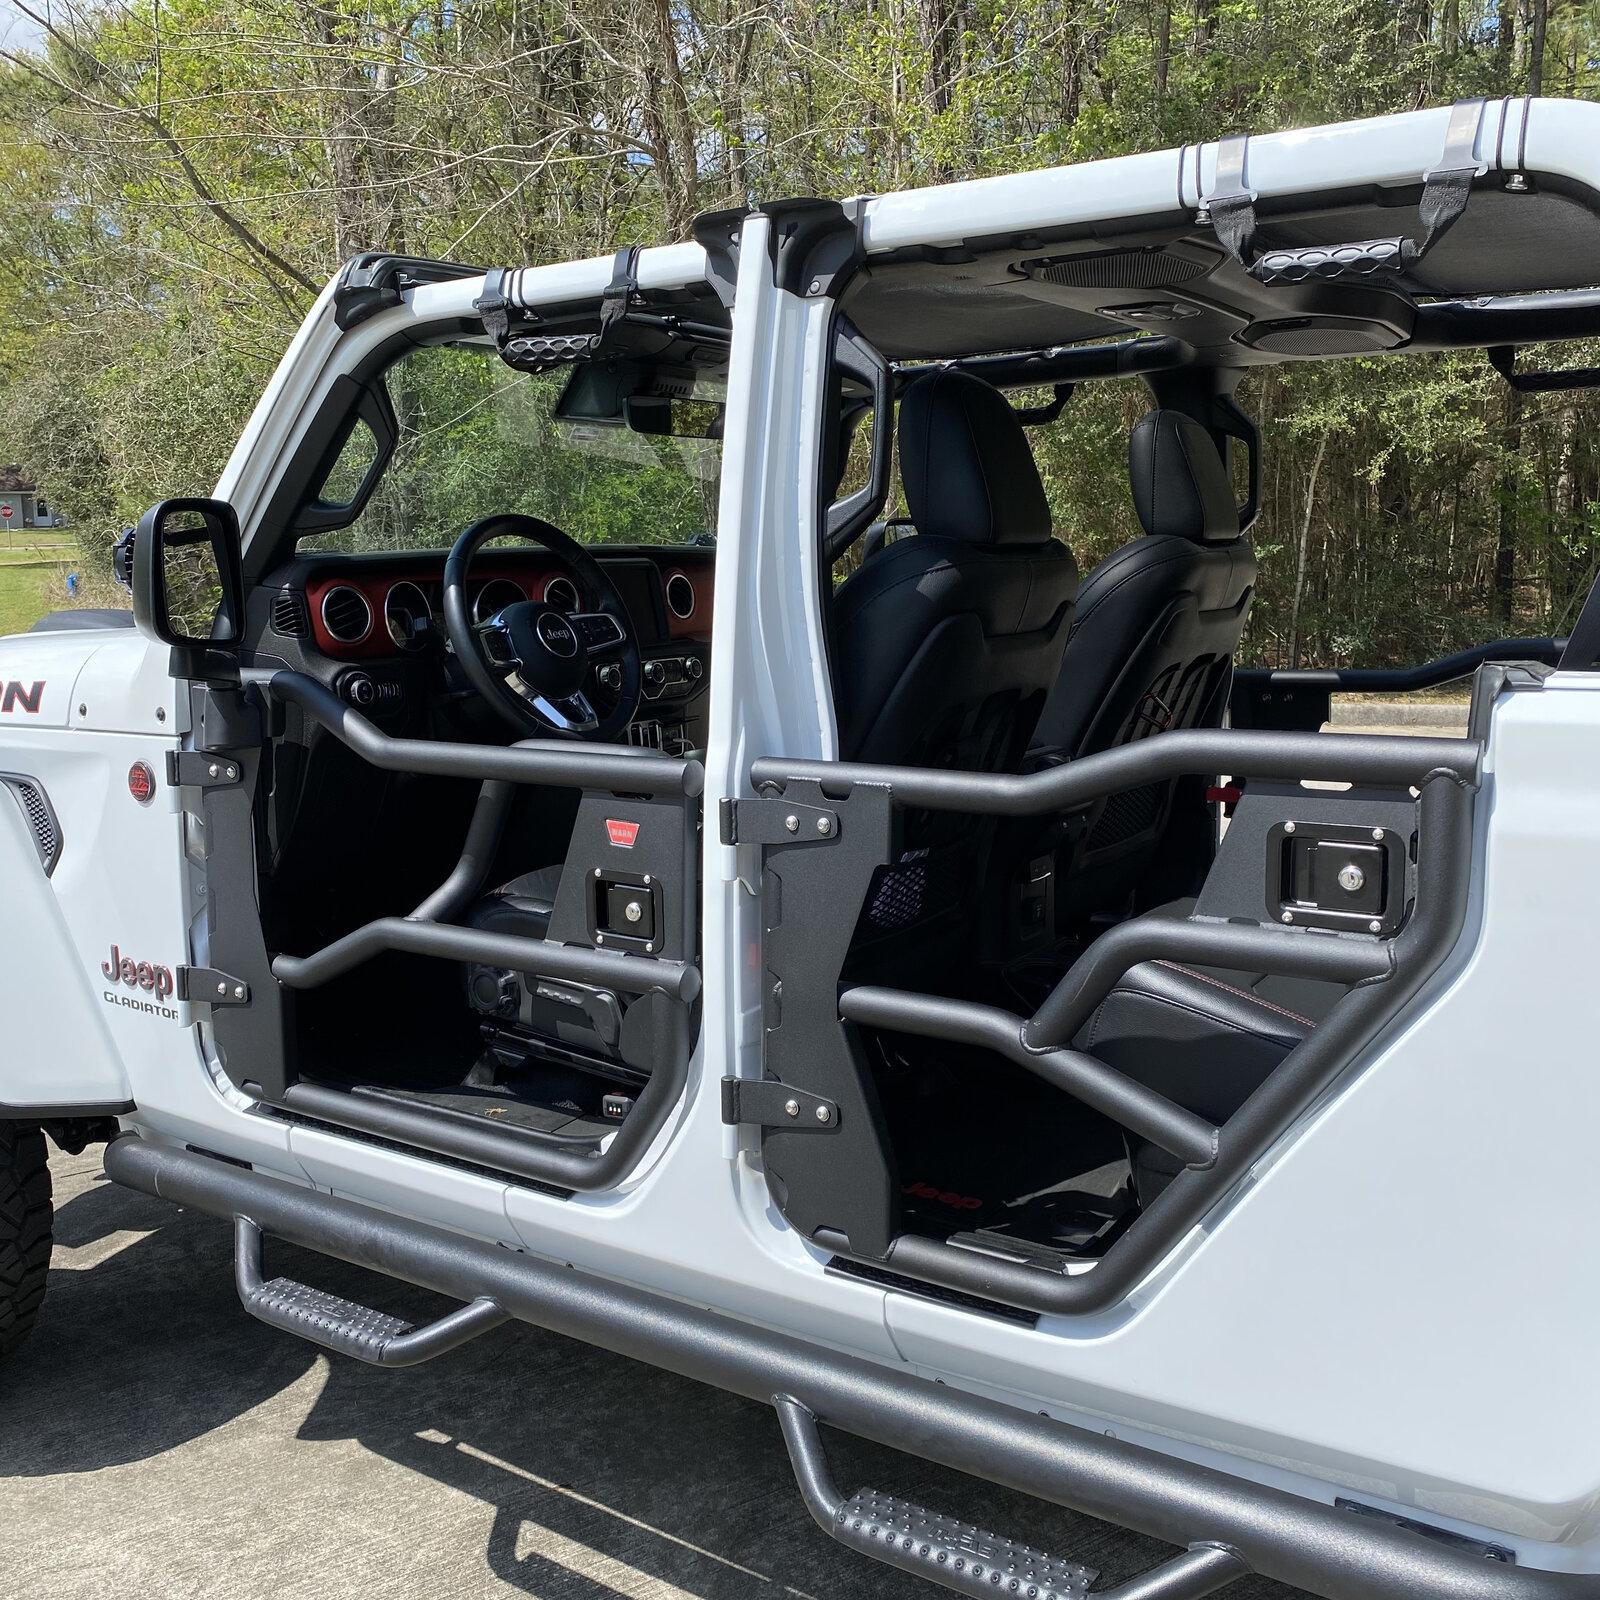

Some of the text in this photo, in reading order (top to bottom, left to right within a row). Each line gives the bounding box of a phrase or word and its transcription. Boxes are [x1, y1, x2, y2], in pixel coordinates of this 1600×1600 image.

[546, 629, 570, 640] Jeep
[0, 680, 46, 713] N
[101, 944, 174, 1002] Jeep
